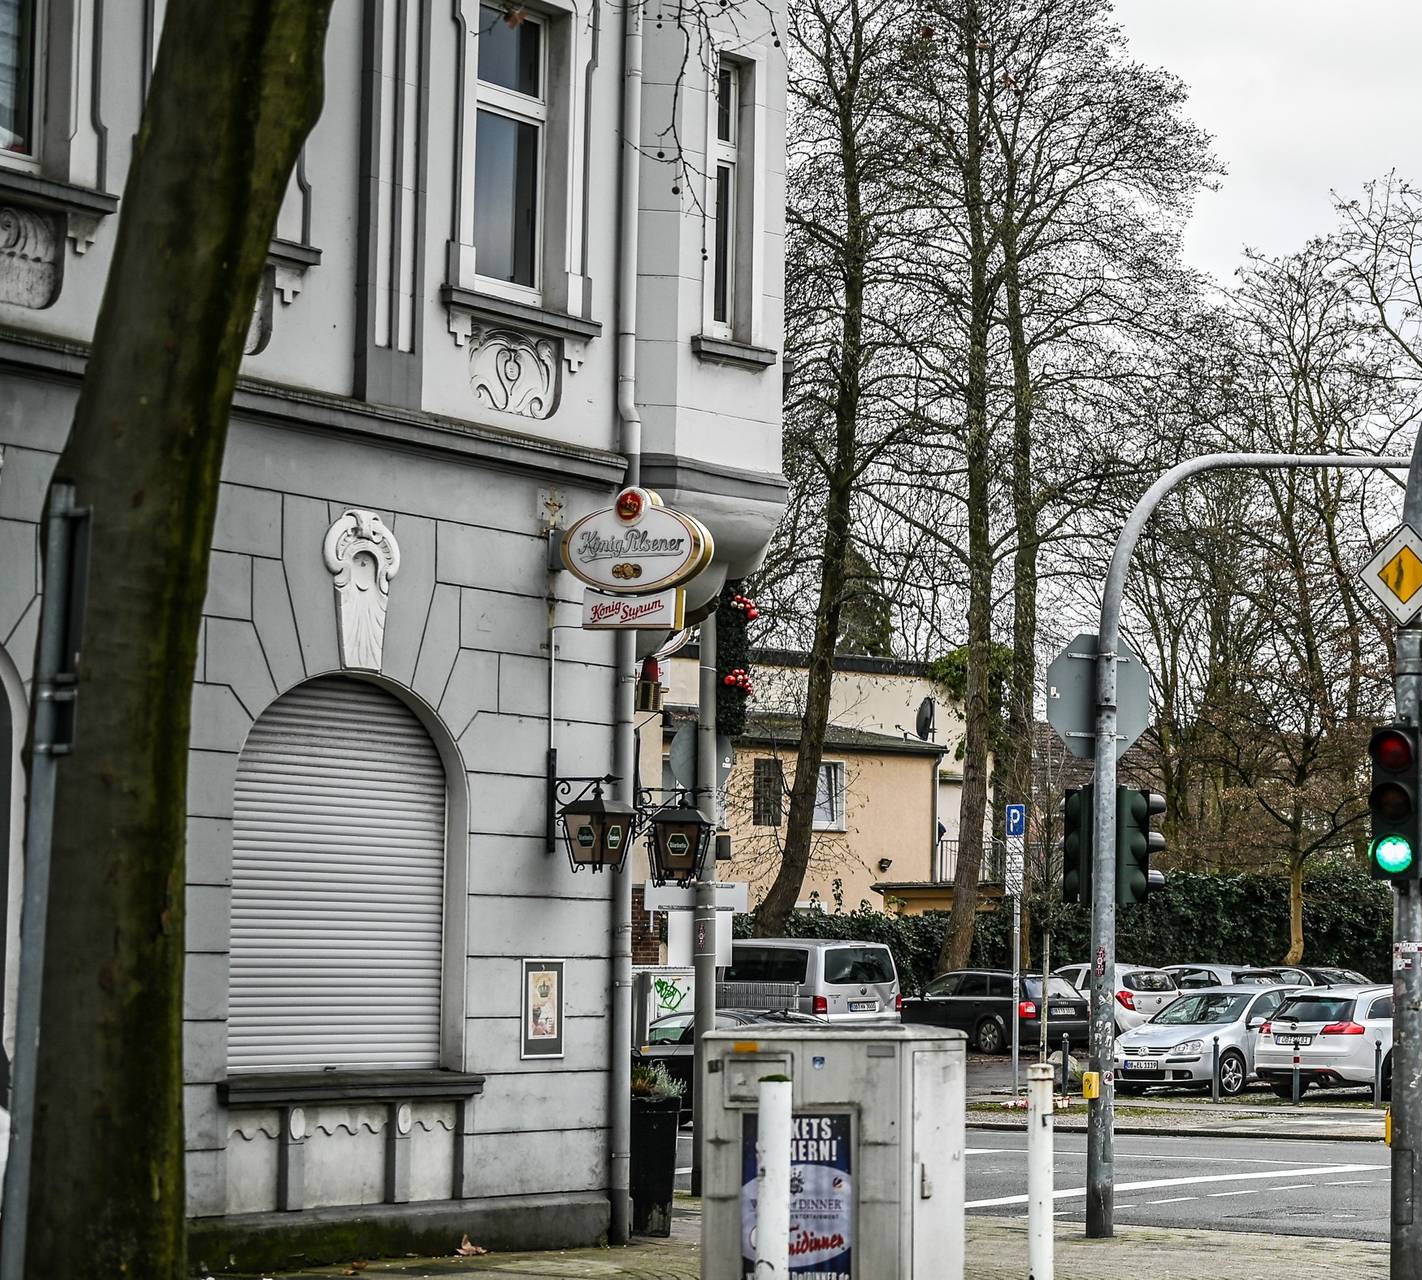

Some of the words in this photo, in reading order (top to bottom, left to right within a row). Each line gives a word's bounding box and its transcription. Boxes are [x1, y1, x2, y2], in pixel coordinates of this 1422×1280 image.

[578, 530, 623, 557] König
[621, 528, 685, 554] Pilsener
[620, 600, 664, 623] Styrum
[1009, 808, 1021, 832] P
[791, 1117, 833, 1140] KETS
[790, 1139, 838, 1162] HERN!
[799, 1199, 842, 1209] DINNER
